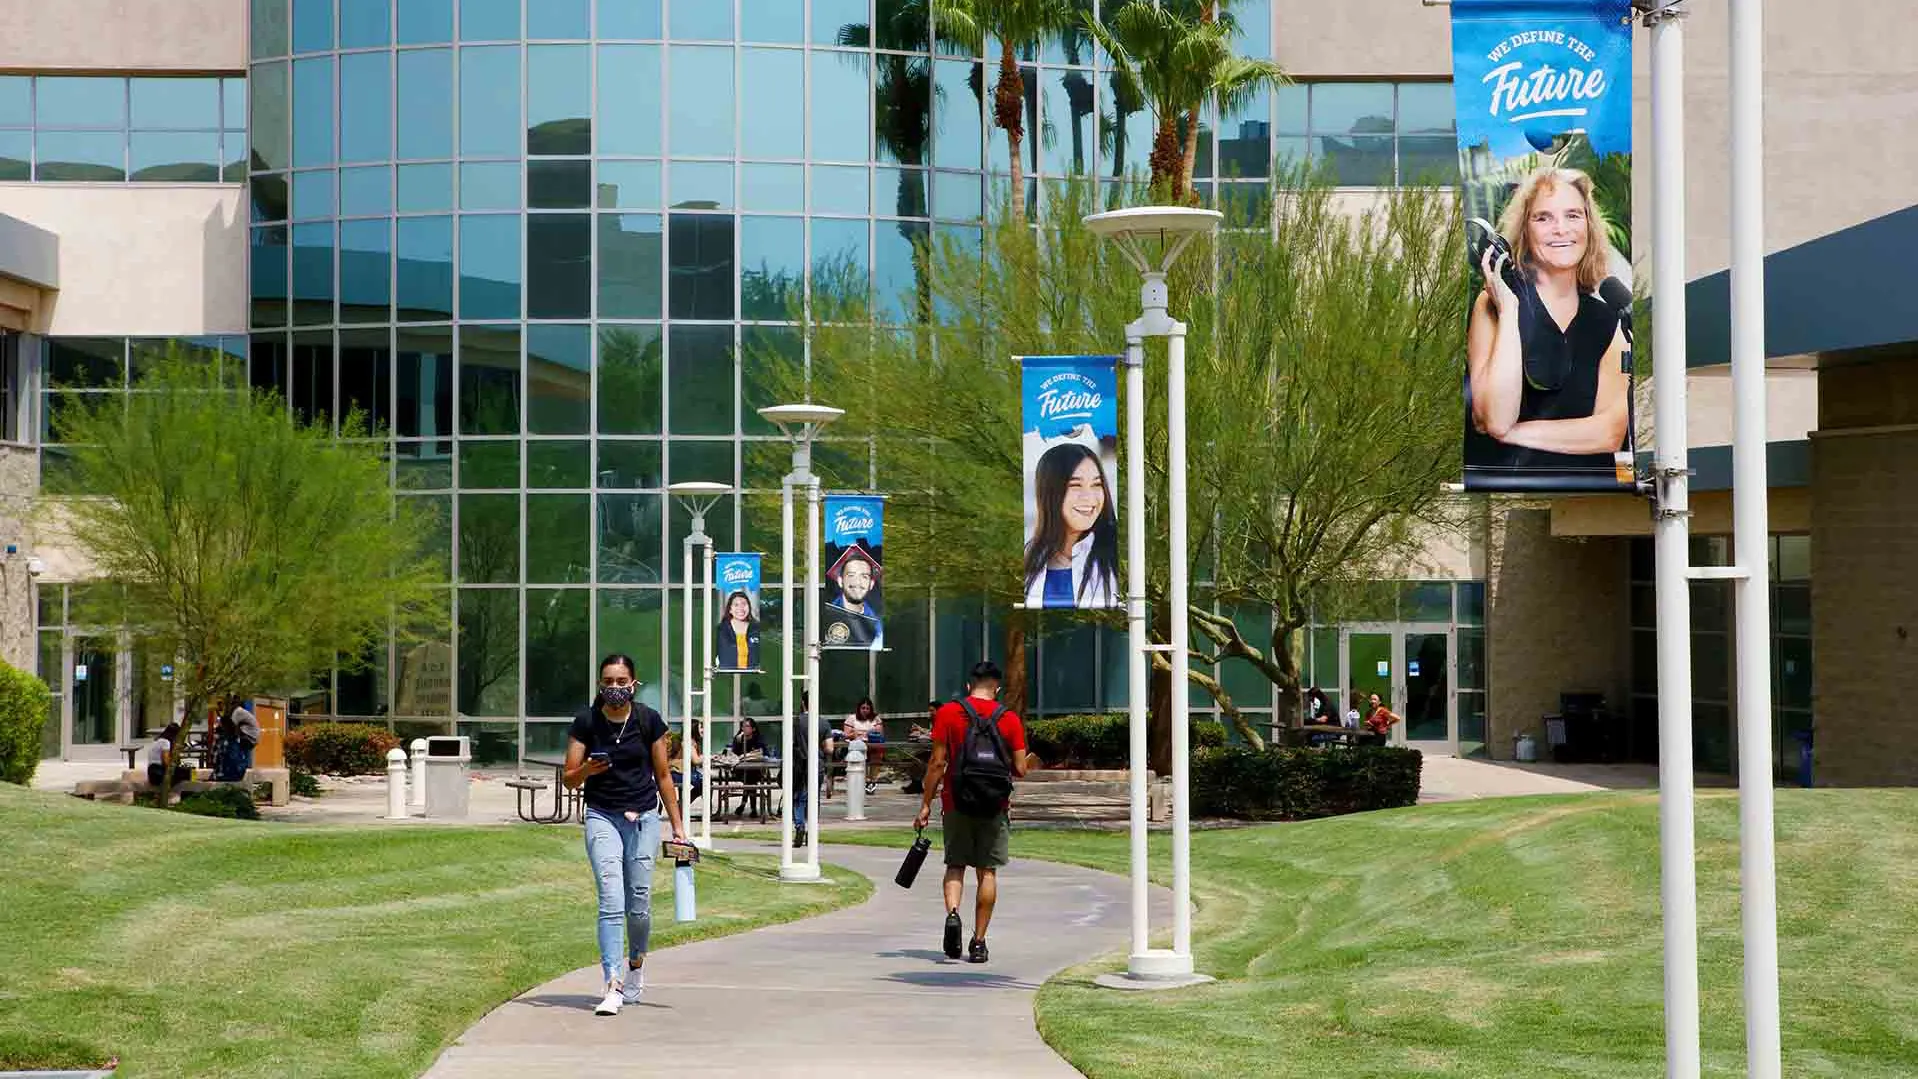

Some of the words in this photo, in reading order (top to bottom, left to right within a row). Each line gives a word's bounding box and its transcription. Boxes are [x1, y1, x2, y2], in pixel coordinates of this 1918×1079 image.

[1488, 41, 1511, 63] WE
[1510, 30, 1566, 48] DEFINE
[1568, 36, 1596, 62] THE
[1482, 61, 1607, 117] Future
[1037, 389, 1102, 418] Future
[833, 515, 874, 533] Future
